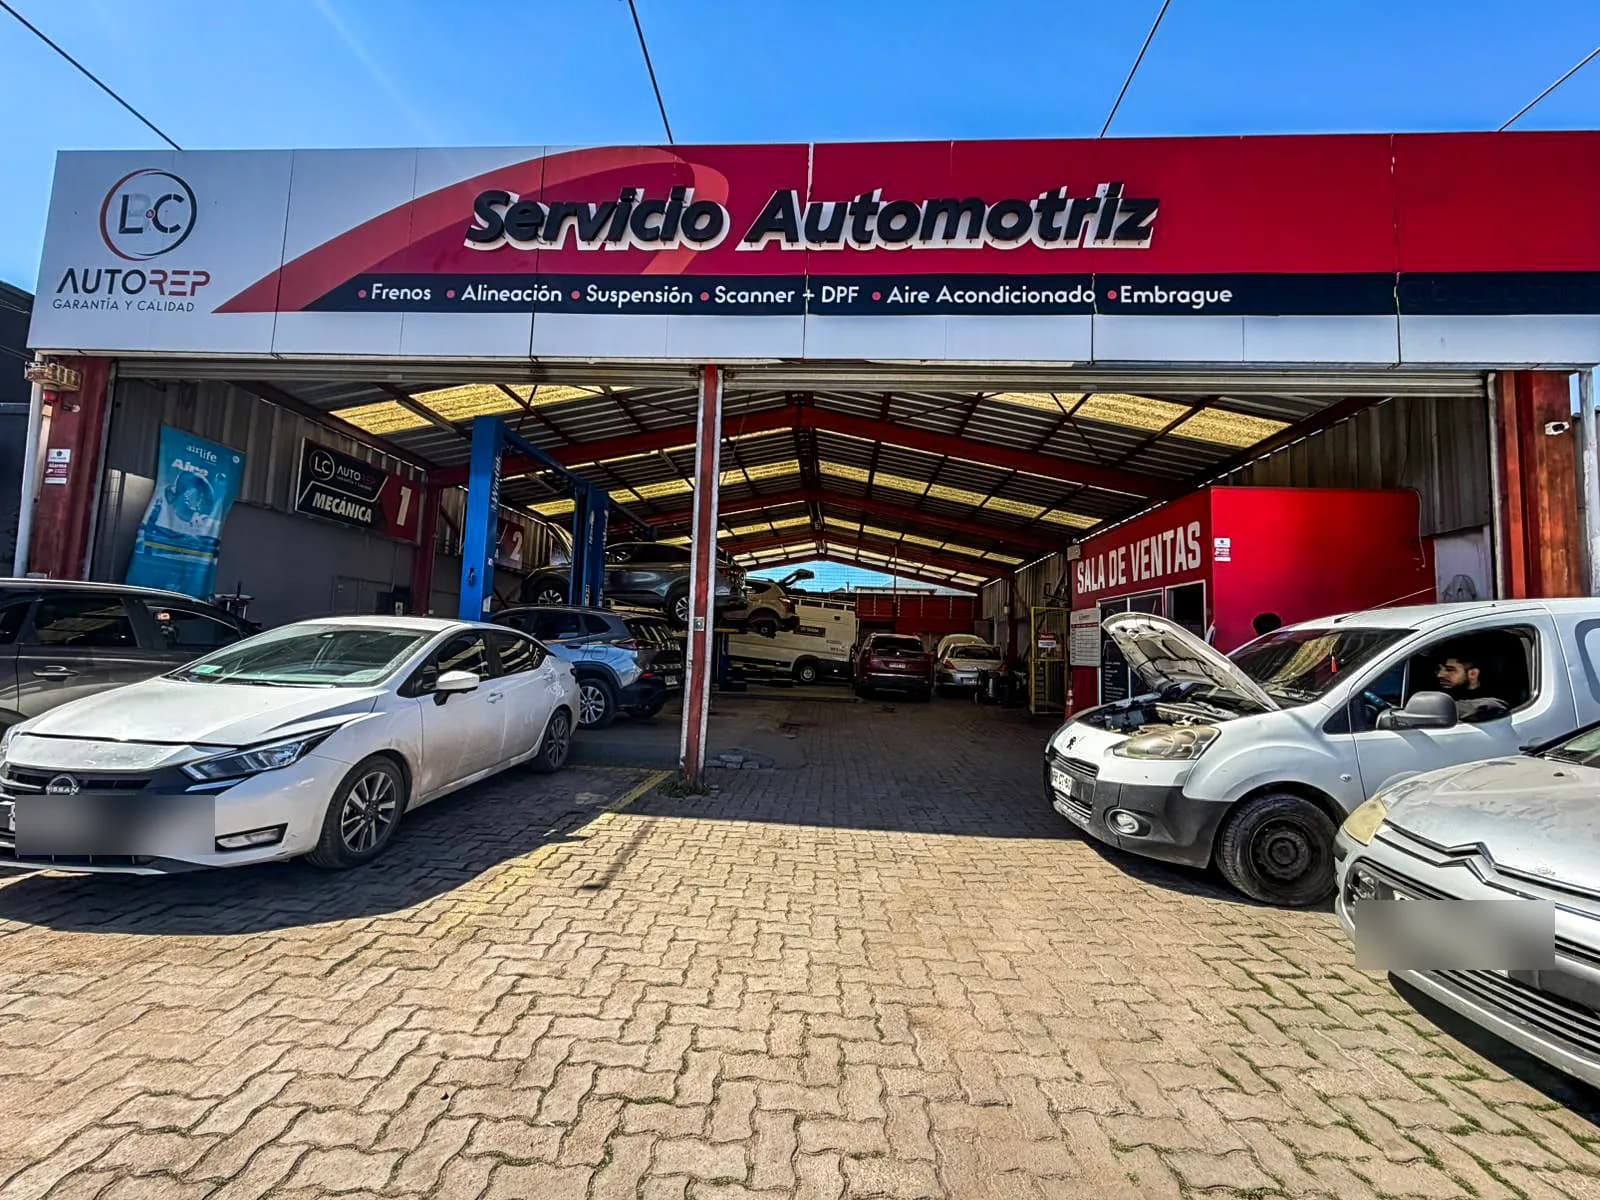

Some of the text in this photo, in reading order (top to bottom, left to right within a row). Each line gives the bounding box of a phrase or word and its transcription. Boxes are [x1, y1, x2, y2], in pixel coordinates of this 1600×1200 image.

[464, 181, 1160, 251] Servicio Automotriz
[56, 267, 211, 297] AUTOREP
[371, 283, 432, 301] Frenos
[460, 284, 563, 303] Alineación
[52, 297, 195, 313] GARANTÍA Y CALIDAD
[585, 284, 694, 308] Suspensión
[714, 285, 796, 304] Scanner
[821, 286, 860, 304] DPF
[886, 285, 1096, 304] Aire Acondicionado
[1119, 285, 1234, 309] Embrague
[185, 444, 218, 463] airlife
[311, 491, 373, 523] MECÁNICA
[396, 485, 412, 527] 1
[509, 530, 523, 562] 2
[1077, 520, 1201, 594] SALA DE VENTAS
[46, 785, 80, 793] NISSAN
